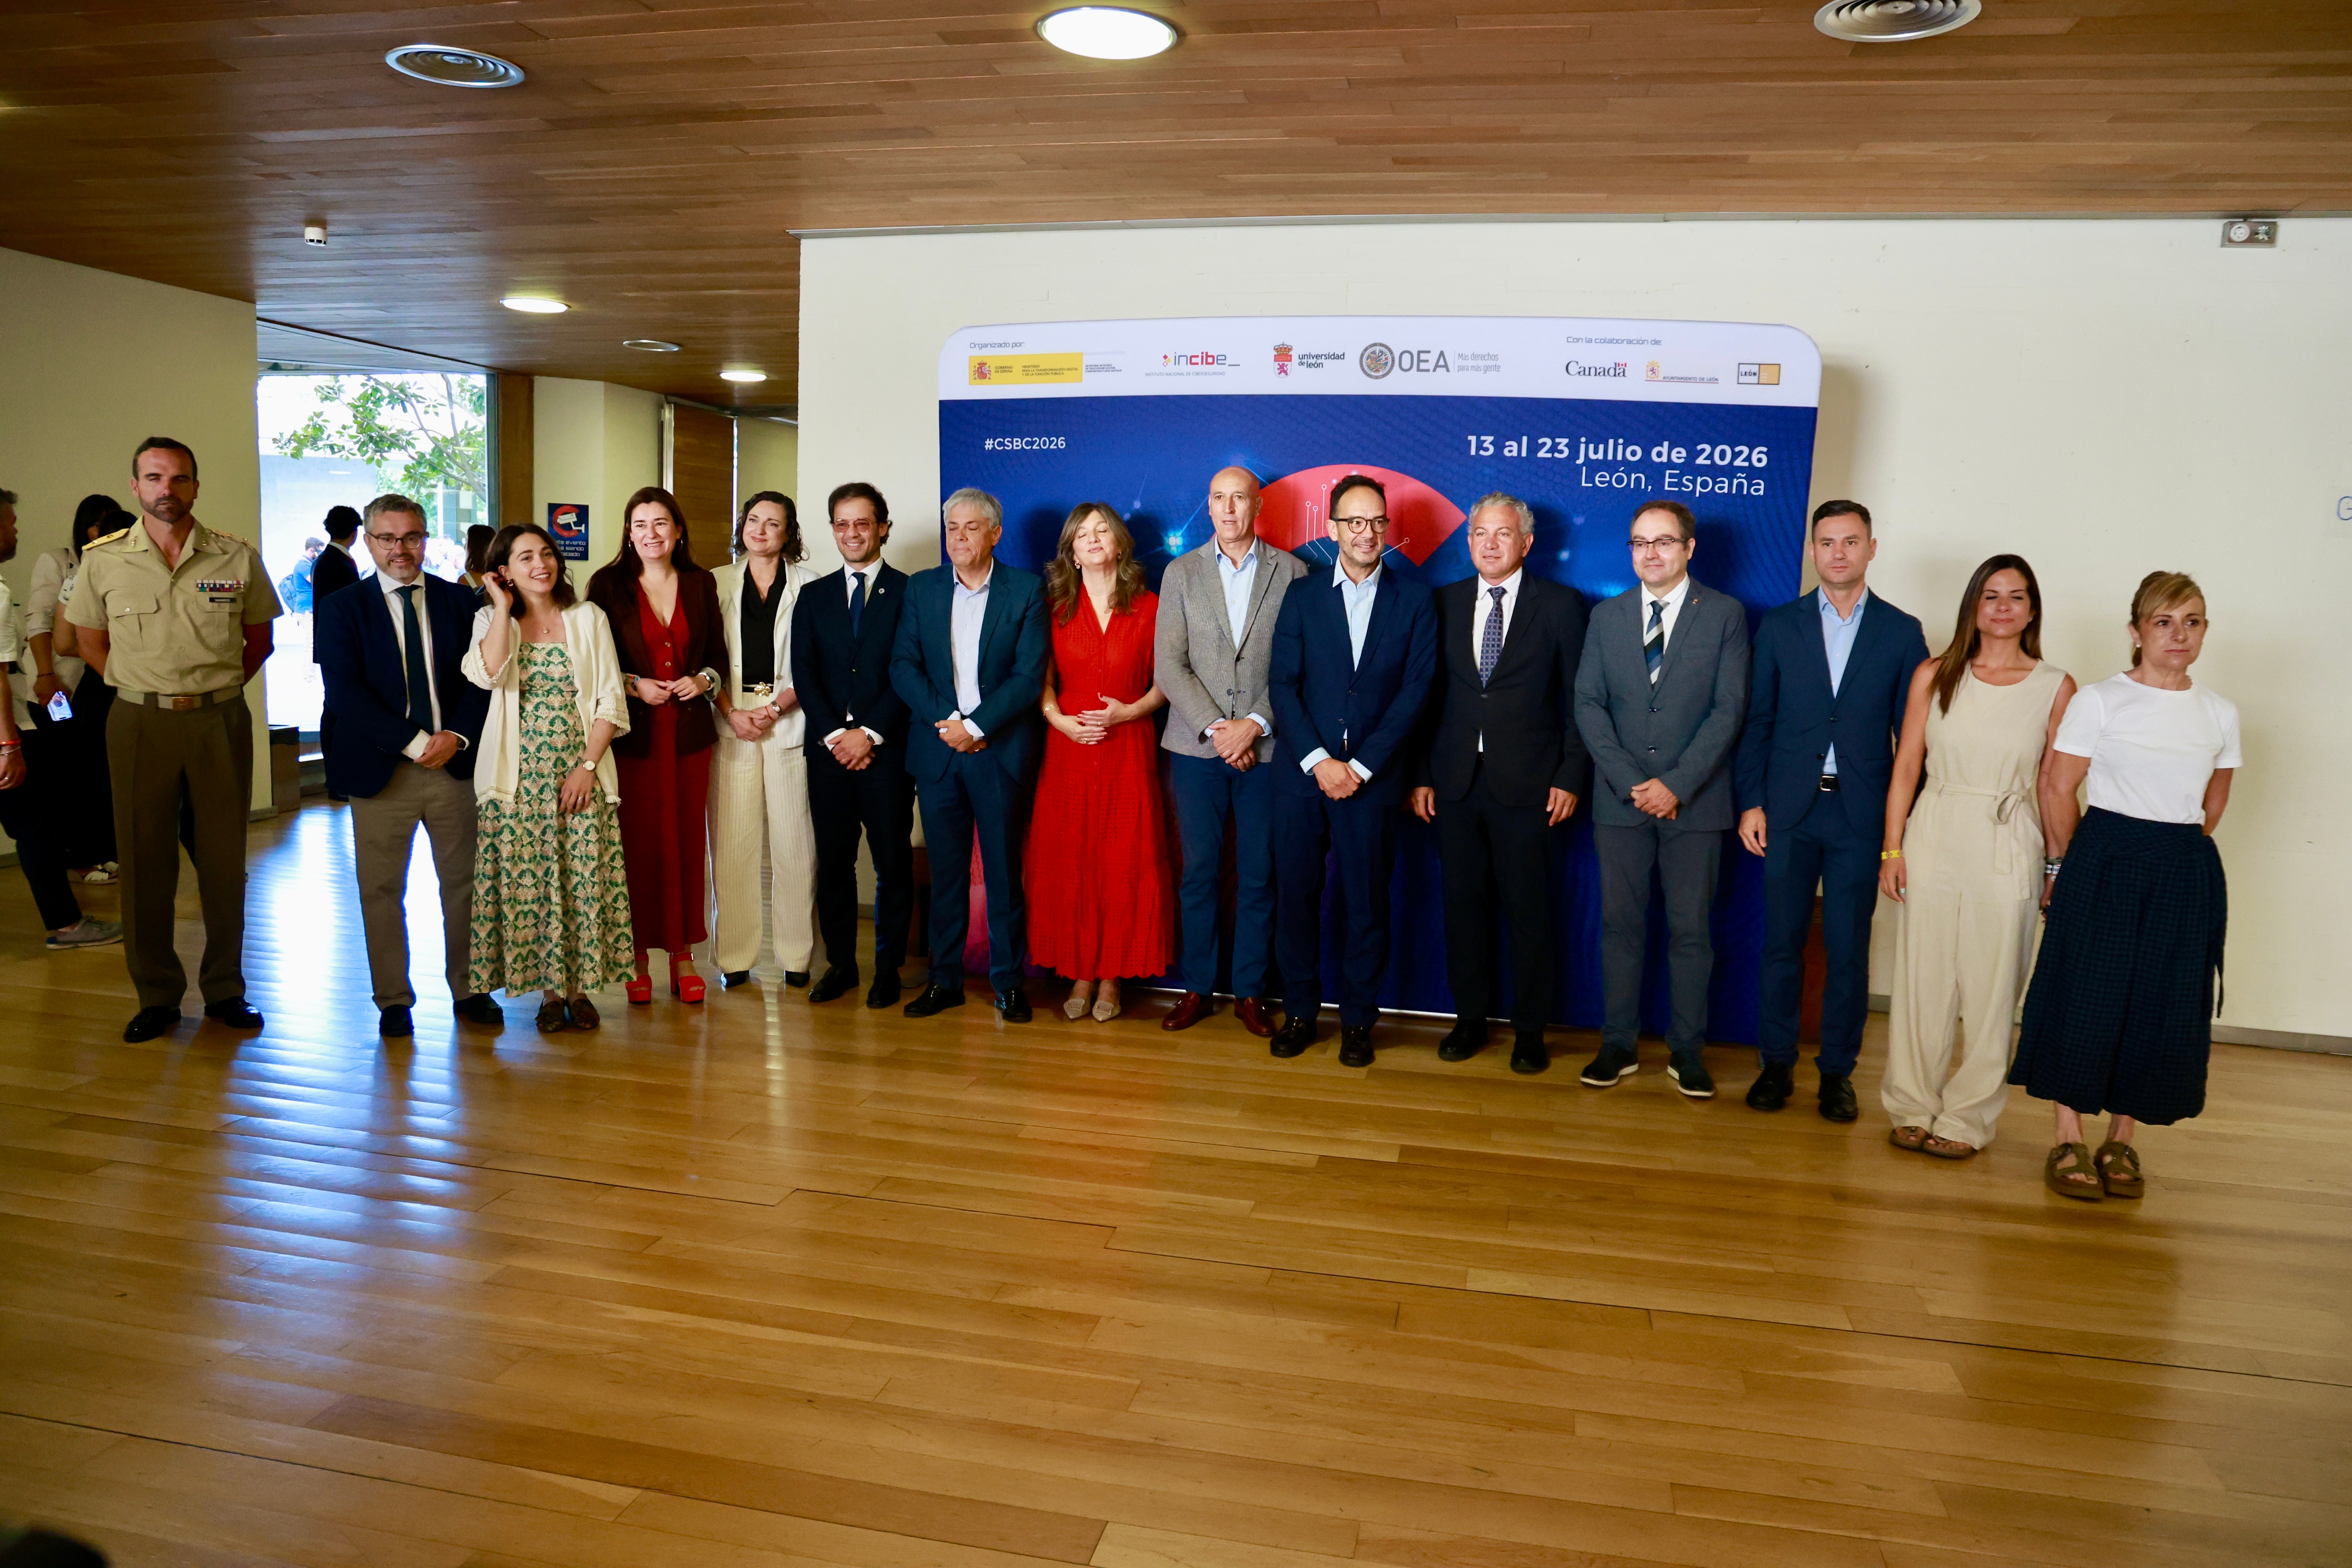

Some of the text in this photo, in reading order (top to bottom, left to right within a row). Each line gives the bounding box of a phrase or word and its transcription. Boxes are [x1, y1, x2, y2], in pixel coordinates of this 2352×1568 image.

[1398, 350, 1450, 372] OEA
[1471, 352, 1499, 361] derechos
[1483, 365, 1501, 373] gente
[1566, 361, 1627, 377] Canada
[984, 437, 1066, 450] #CSBC2026
[1467, 435, 1768, 468] 13 al 23 julio de 2026
[1581, 466, 1765, 497] León, España
